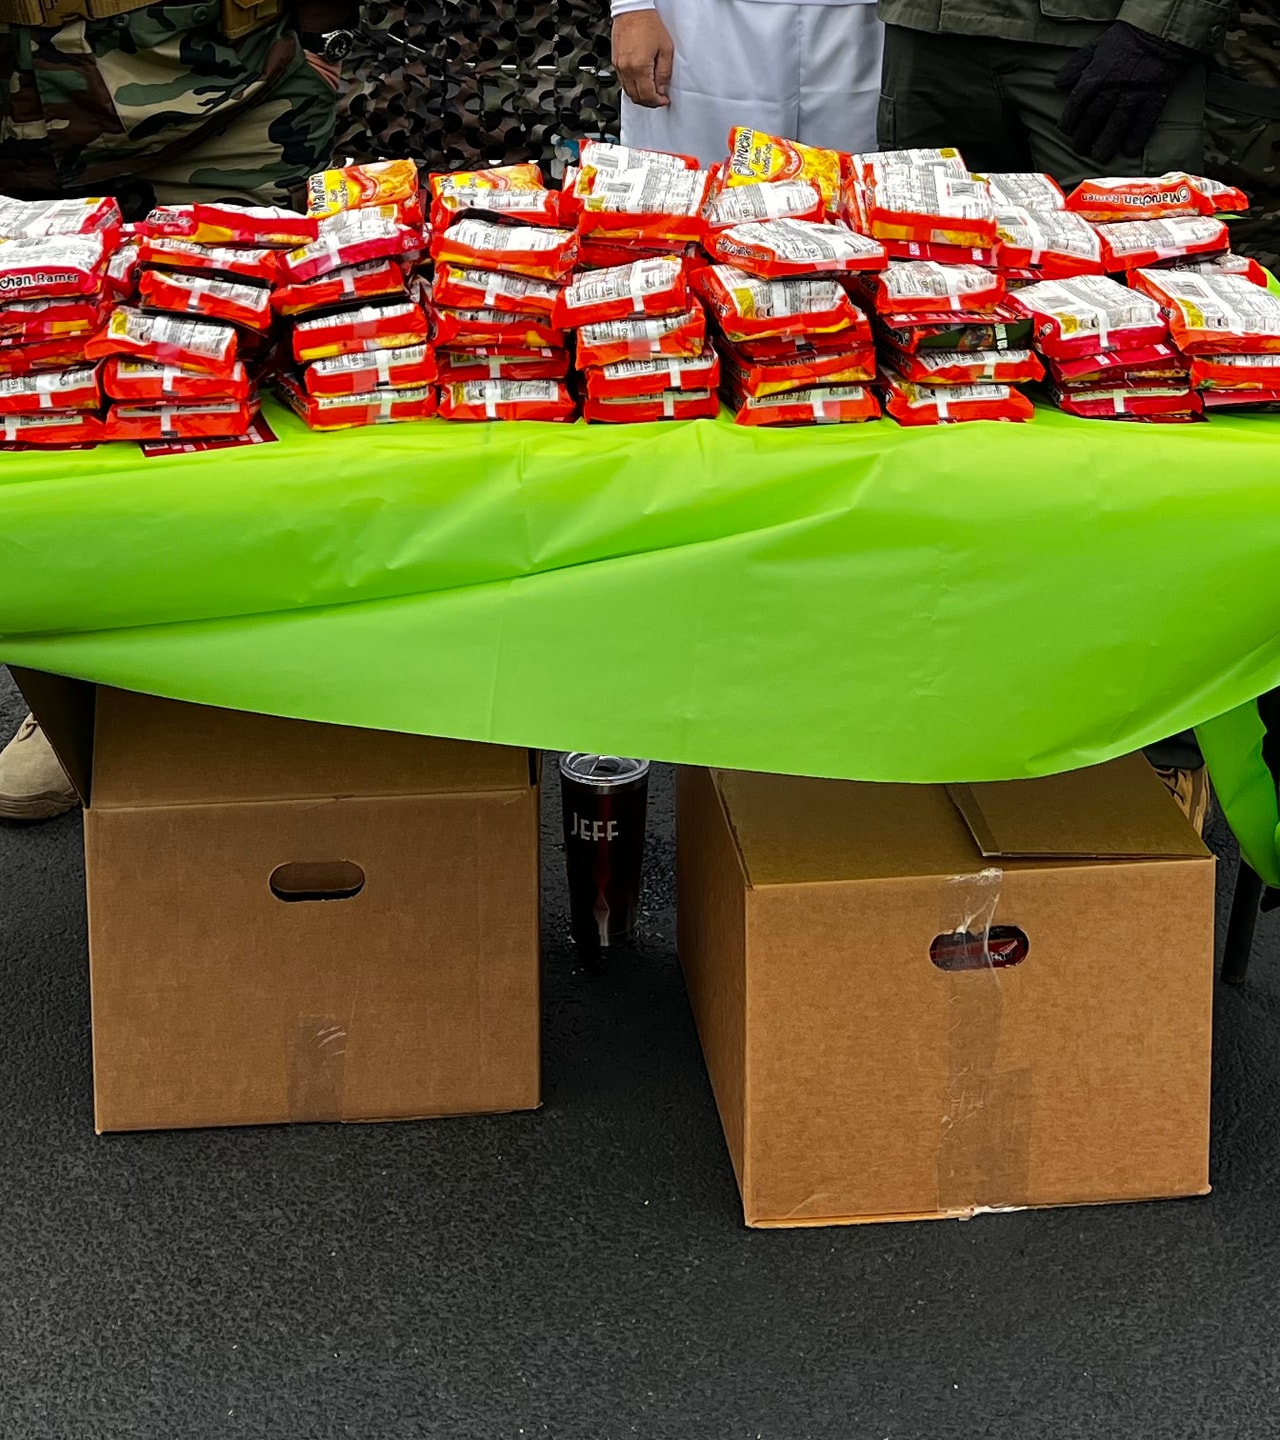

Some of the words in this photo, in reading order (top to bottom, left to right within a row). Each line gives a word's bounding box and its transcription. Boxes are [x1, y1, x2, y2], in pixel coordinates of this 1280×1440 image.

[1082, 193, 1119, 203] Ramen
[1124, 187, 1181, 206] Maruchan
[571, 812, 619, 841] JEFF
